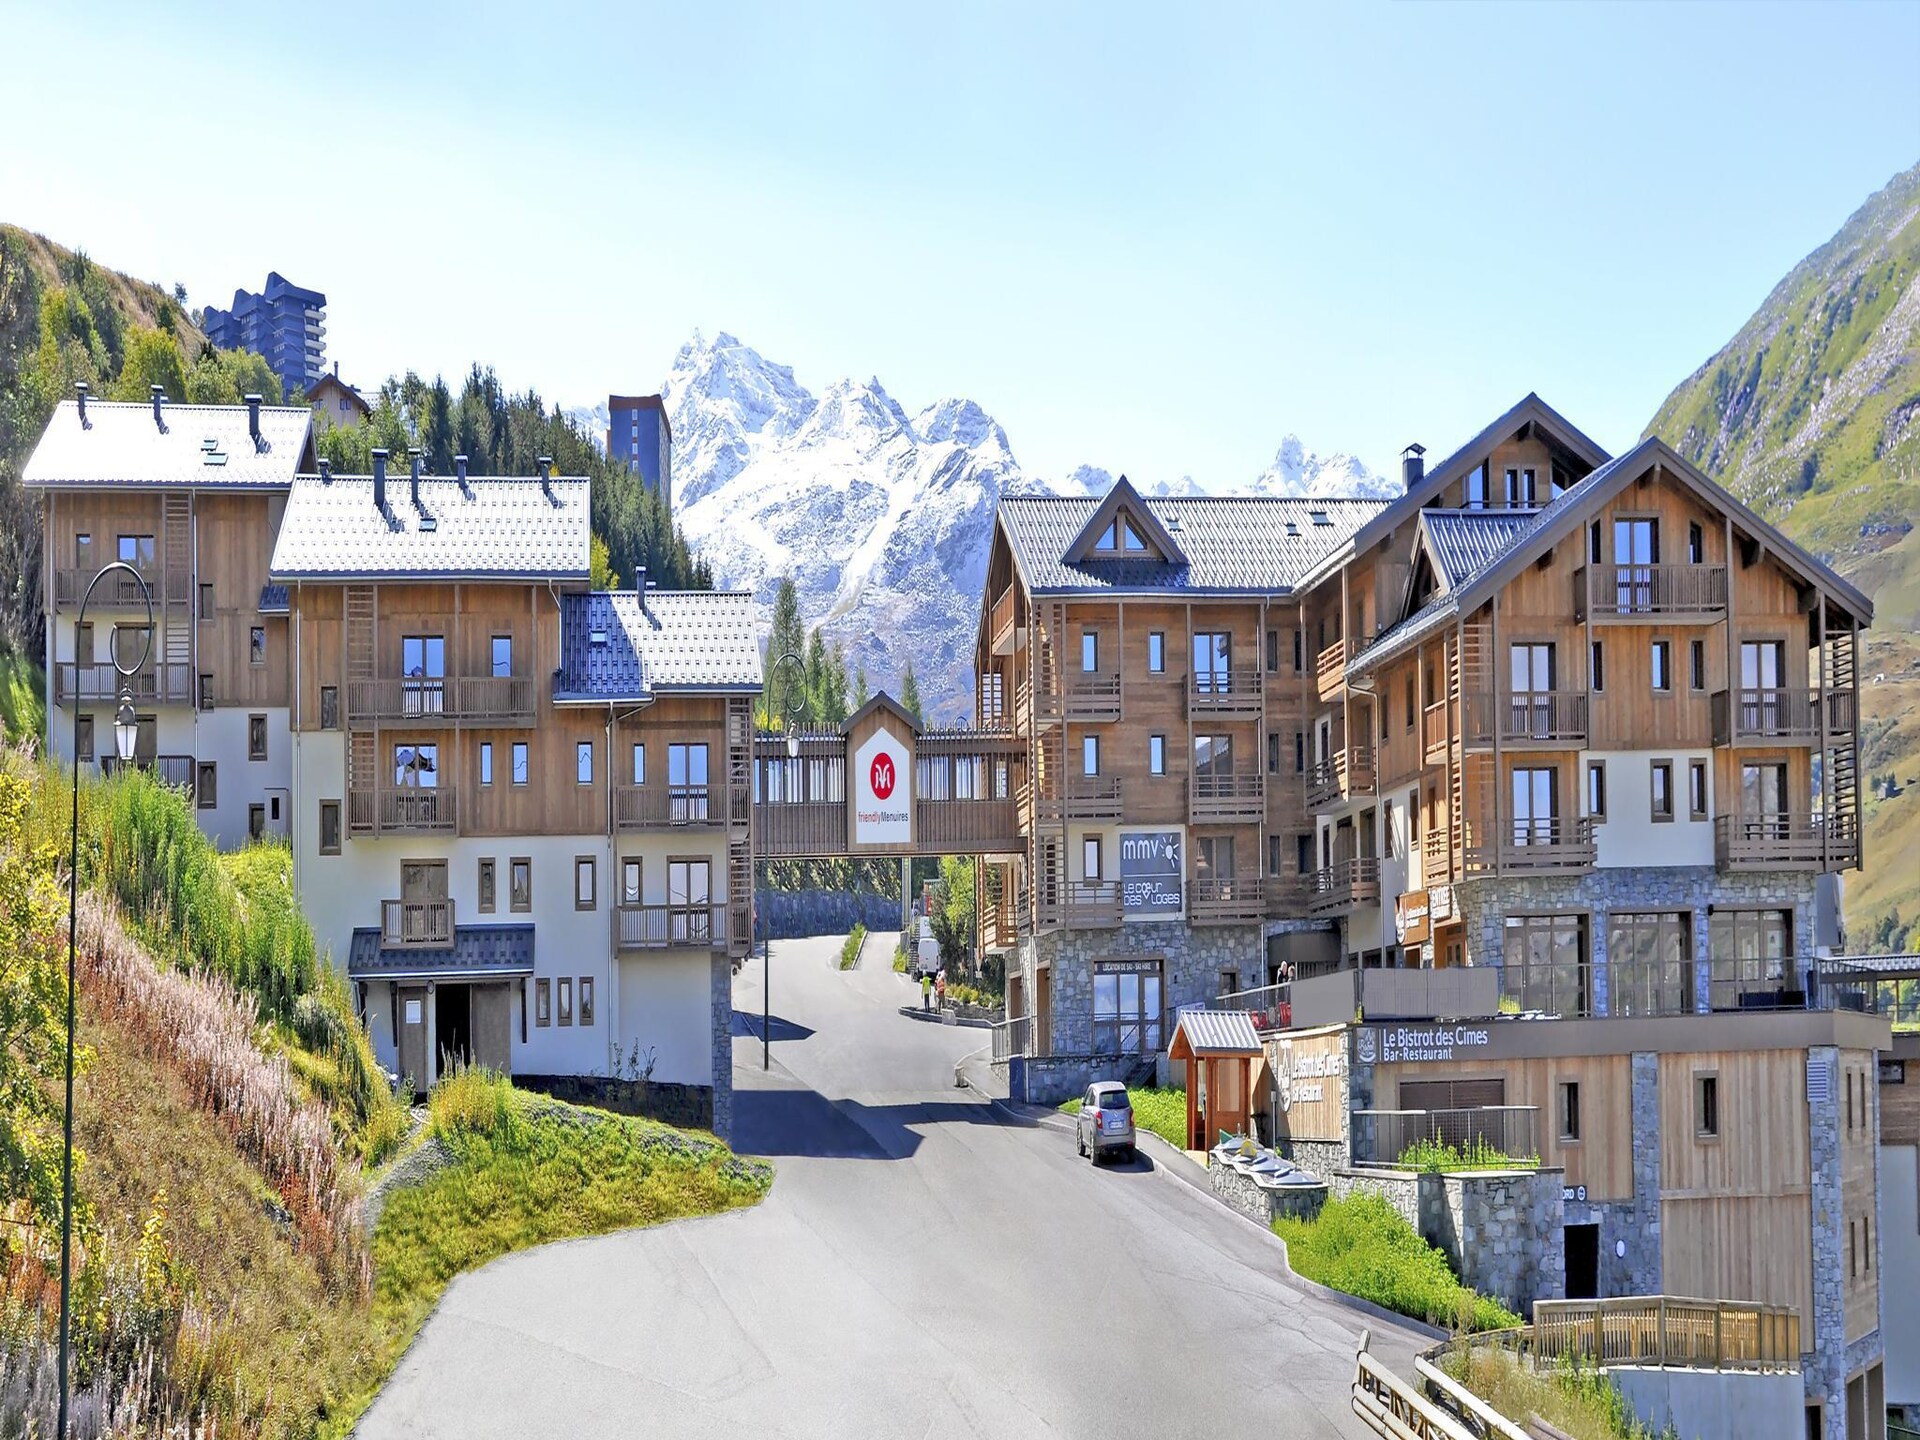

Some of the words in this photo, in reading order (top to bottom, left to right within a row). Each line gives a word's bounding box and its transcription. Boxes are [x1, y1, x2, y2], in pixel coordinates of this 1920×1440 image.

[858, 811, 909, 824] friendlyMenuires
[1123, 840, 1159, 859] mmv
[1123, 883, 1134, 894] Le
[1383, 1028, 1396, 1047] Le
[1397, 1028, 1434, 1047] Bistrot
[1435, 1026, 1454, 1046] des
[1455, 1026, 1488, 1046] Cimes
[1383, 1047, 1453, 1062] Bar-Restaurant
